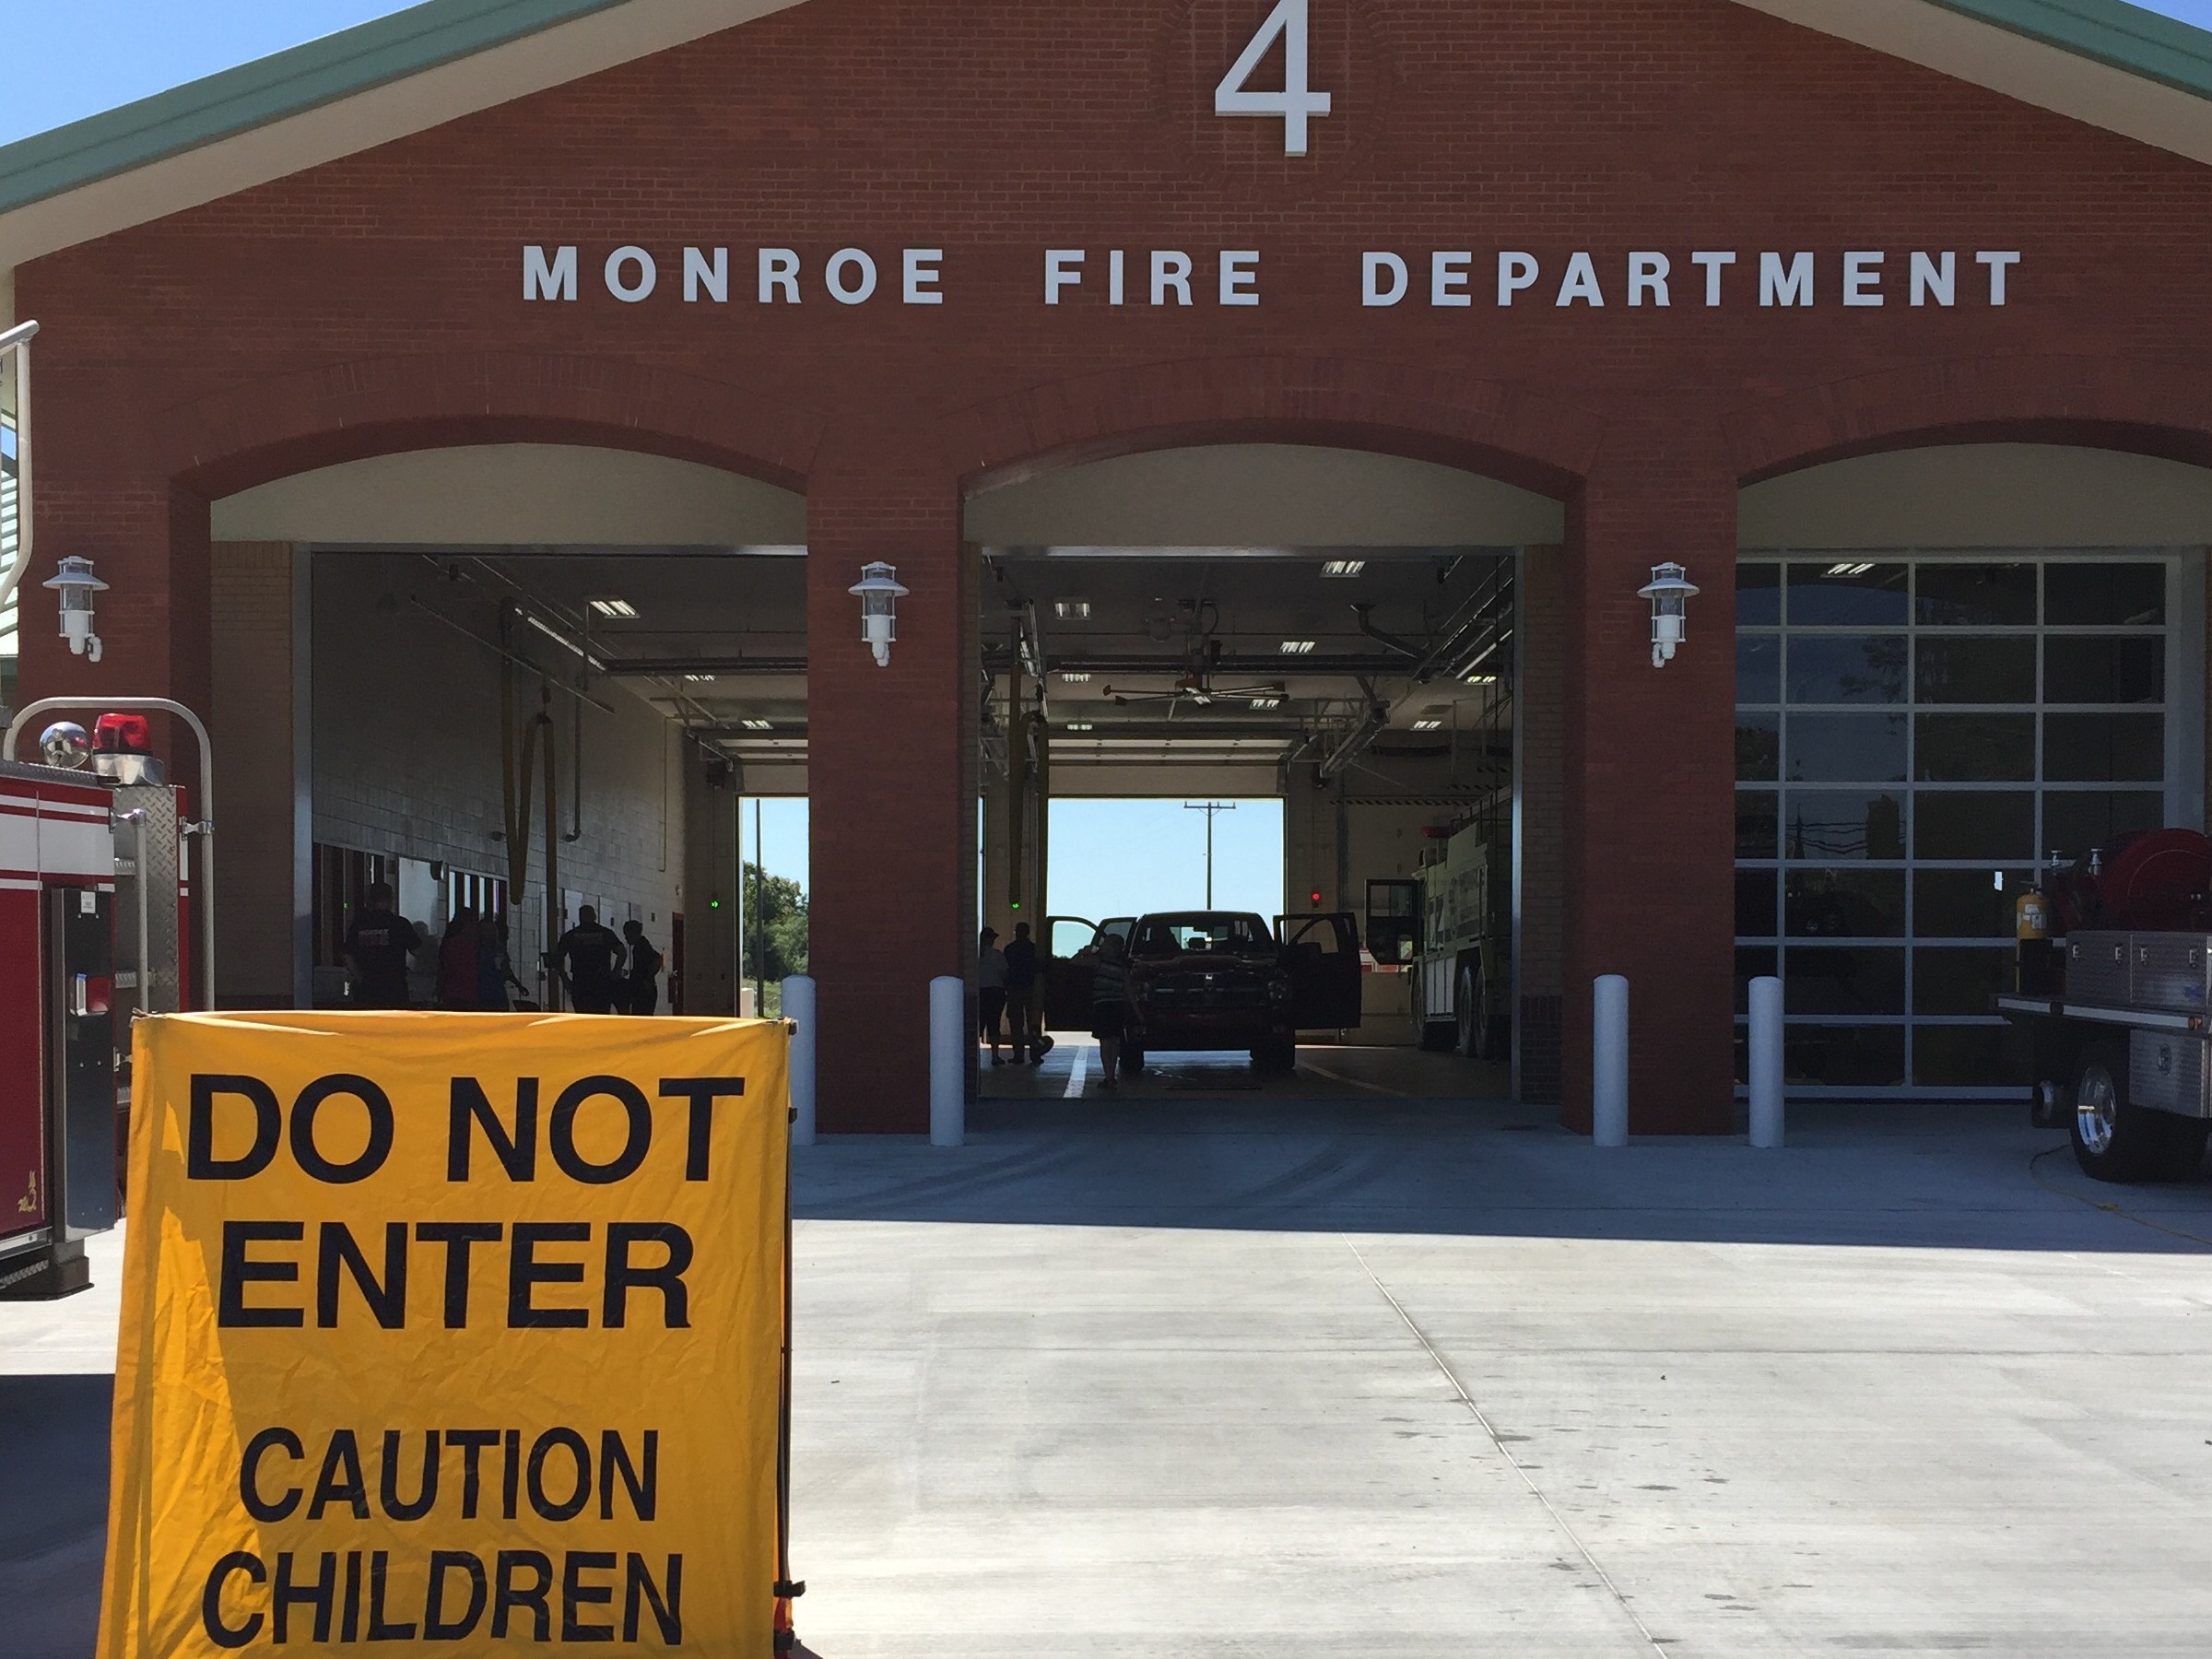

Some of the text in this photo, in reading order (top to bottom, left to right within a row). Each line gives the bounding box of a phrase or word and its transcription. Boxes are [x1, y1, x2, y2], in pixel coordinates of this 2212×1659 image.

[1215, 0, 1331, 156] 4
[523, 246, 2020, 306] MONROE FIRE DEPARTMENT
[187, 1074, 745, 1184] DO NOT
[218, 1221, 694, 1329] ENTER
[240, 1427, 658, 1523] CAUTION
[203, 1550, 682, 1648] CHILDREN
